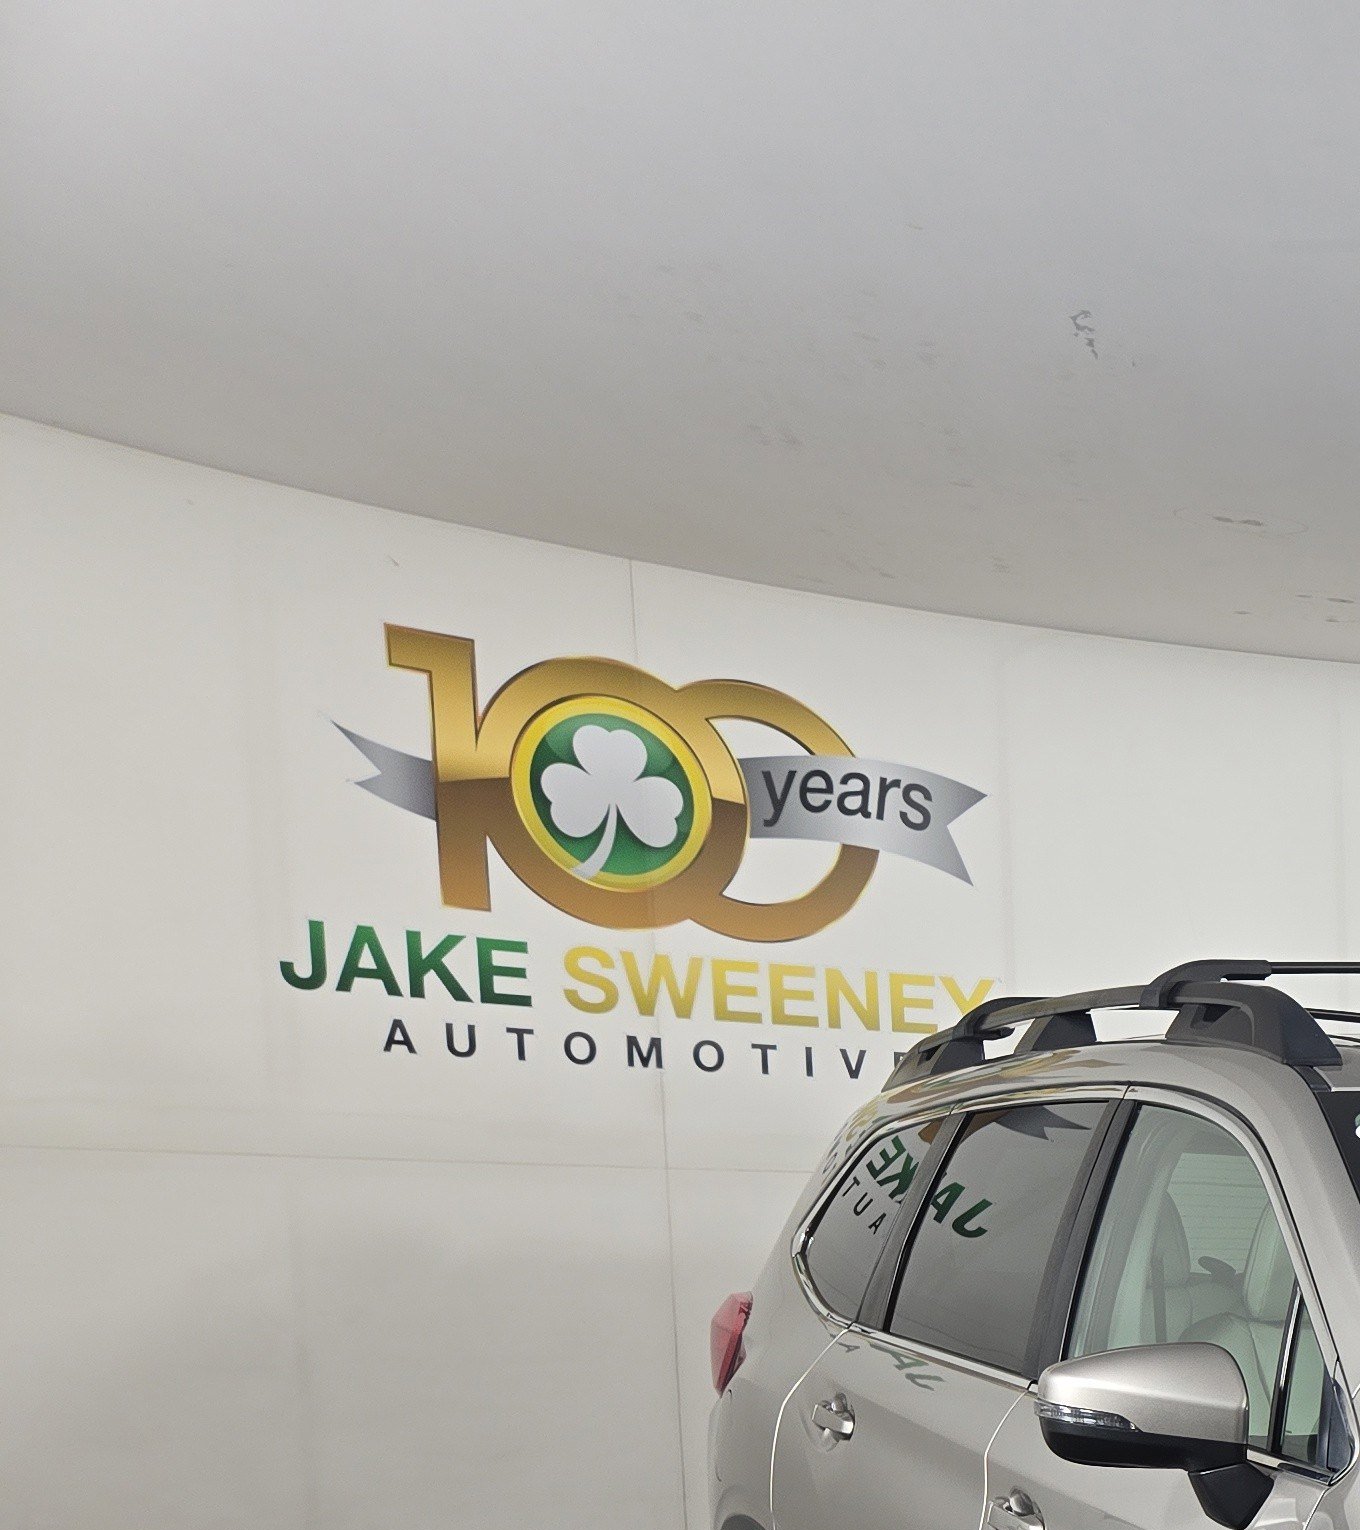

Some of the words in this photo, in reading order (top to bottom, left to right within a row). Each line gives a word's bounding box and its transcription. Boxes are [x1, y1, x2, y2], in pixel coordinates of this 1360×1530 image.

[384, 623, 879, 943] 100
[761, 768, 932, 832] years
[280, 920, 533, 1007] JAKE
